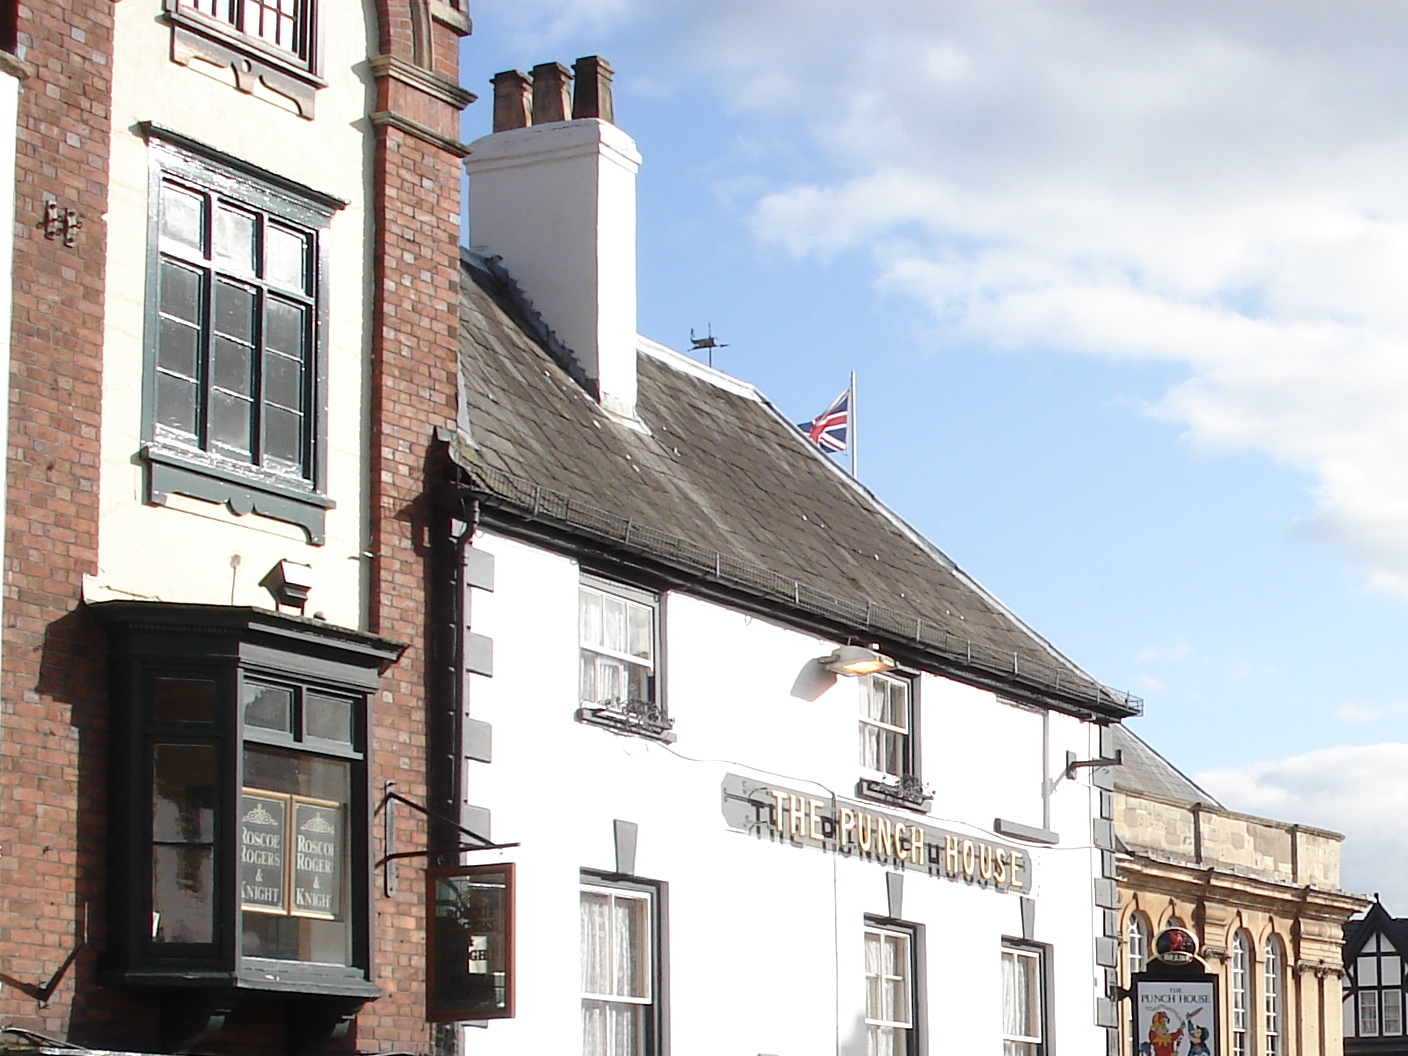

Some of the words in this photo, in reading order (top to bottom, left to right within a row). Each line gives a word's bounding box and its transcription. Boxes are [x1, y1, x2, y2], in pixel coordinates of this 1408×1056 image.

[771, 789, 825, 841] THE
[840, 806, 925, 867] PUNCH
[944, 834, 1024, 888] HOUSE
[255, 868, 263, 882] &
[313, 875, 321, 889] &
[1141, 994, 1176, 1004] PUNCH
[1179, 994, 1211, 1004] HOUSE
